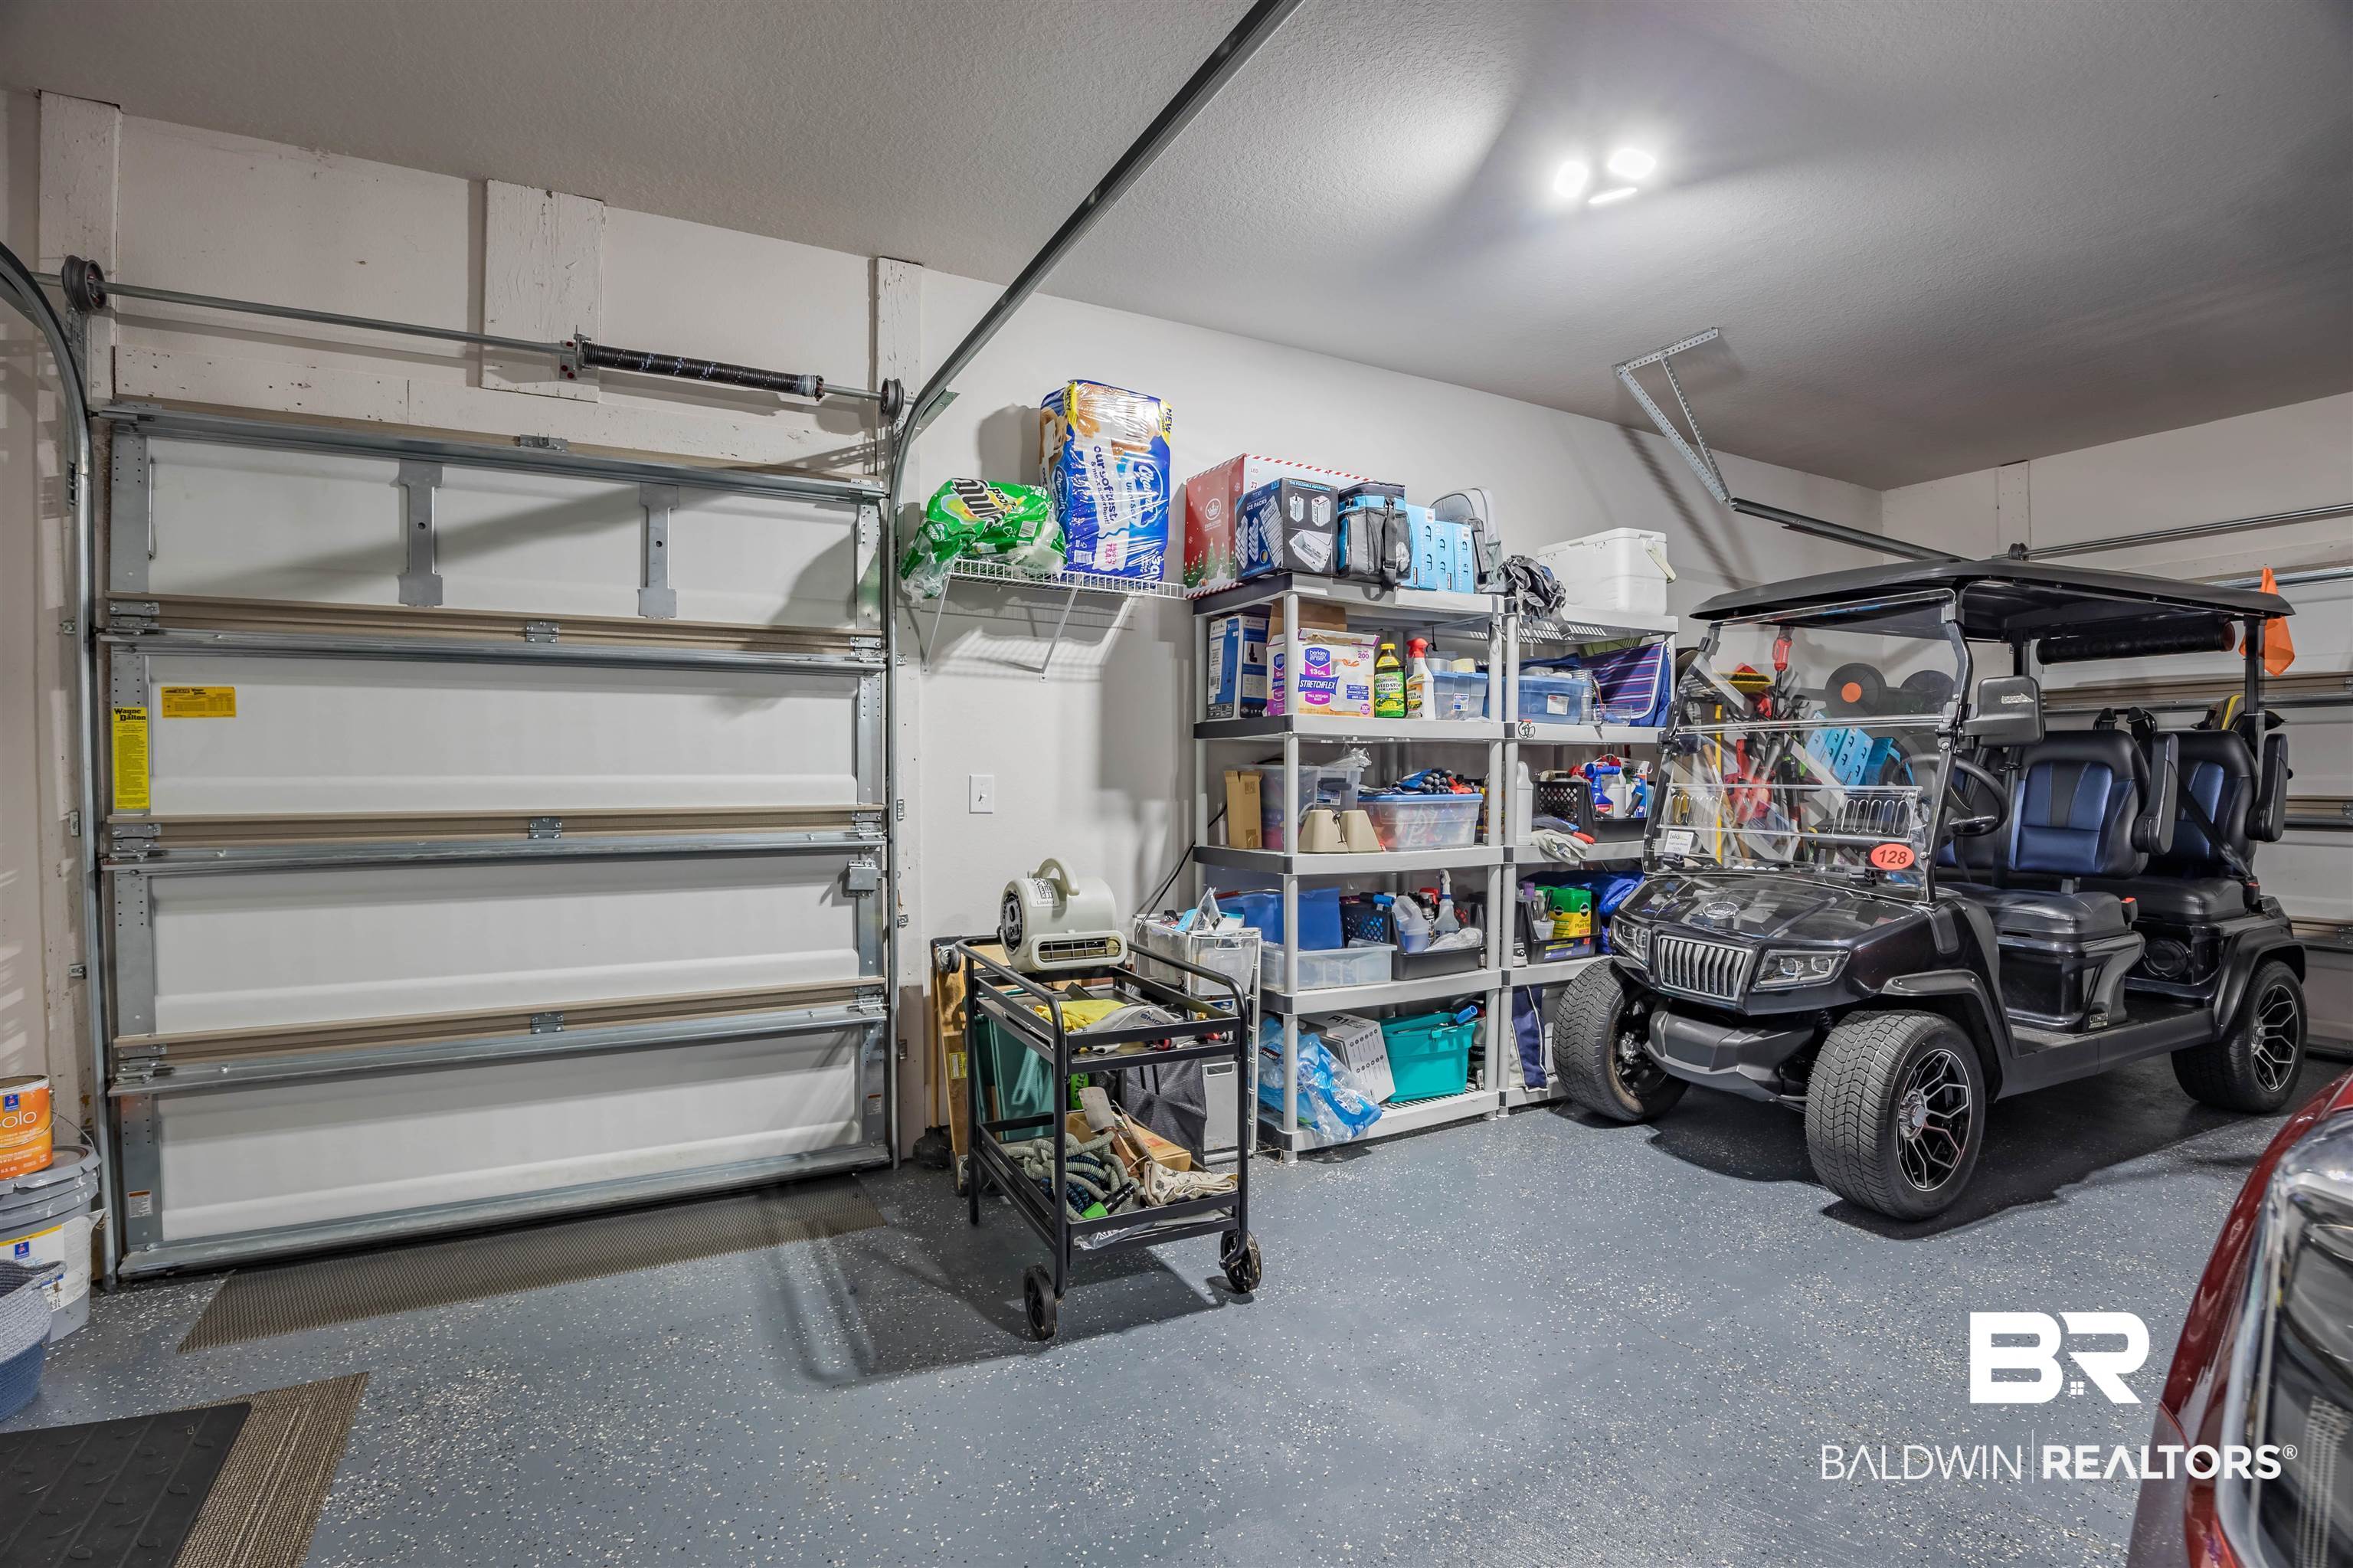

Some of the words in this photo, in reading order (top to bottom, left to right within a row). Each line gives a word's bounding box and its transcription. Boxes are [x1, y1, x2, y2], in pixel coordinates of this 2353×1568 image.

[1093, 445, 1106, 470] our
[1056, 470, 1065, 510] Charmin
[1254, 499, 1268, 507] PACKS
[1300, 679, 1336, 689] STRETCHFLEX
[114, 708, 141, 716] Wayne
[1880, 849, 1907, 864] 128
[0, 1111, 37, 1128] olo
